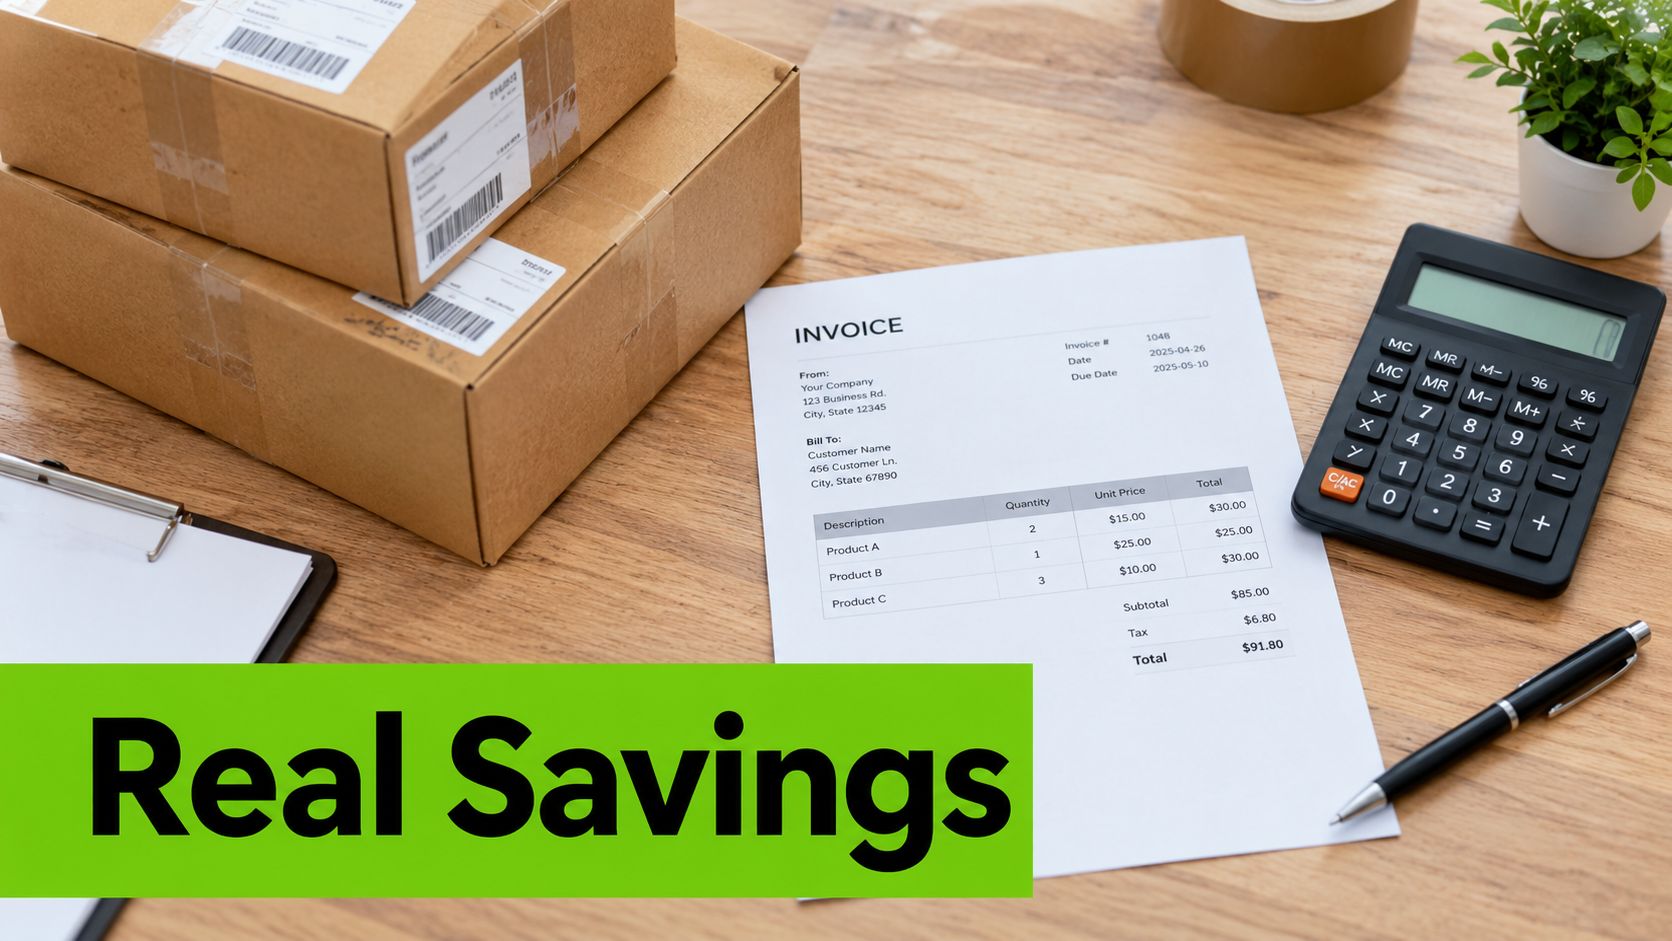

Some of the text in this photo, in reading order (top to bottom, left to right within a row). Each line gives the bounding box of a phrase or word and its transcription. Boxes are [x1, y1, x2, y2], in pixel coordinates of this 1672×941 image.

[795, 317, 904, 343] INVOICE
[1065, 340, 1100, 350] Invoice
[1150, 345, 1206, 357] 2025-04-26
[1388, 337, 1413, 353] MC
[1068, 357, 1092, 365] Date
[1434, 350, 1458, 365] MR
[1153, 360, 1209, 372] 2025-05-10
[1376, 362, 1404, 379] MC
[800, 370, 830, 379] From:
[1071, 370, 1118, 381] Due Date
[801, 378, 874, 392] Your Company
[1422, 375, 1449, 392] MR
[803, 389, 887, 406] 123 Business Rd.
[1467, 389, 1493, 403] M-
[803, 403, 887, 419] City, State 12345
[1421, 404, 1433, 419] 7
[1514, 402, 1541, 417] M+
[1463, 418, 1477, 433] 8
[806, 436, 842, 446] Bill To:
[1406, 432, 1419, 447] 4
[1511, 430, 1524, 446] 9
[808, 444, 891, 460] Customer Name
[1452, 445, 1466, 460] 5
[809, 457, 898, 473] 456 Customer Ln.
[1398, 460, 1407, 476] 1
[1499, 459, 1512, 474] 6
[811, 472, 898, 489] City, State 67890
[1196, 478, 1223, 489] Total
[1441, 474, 1455, 489] 2
[1094, 487, 1146, 500] Unit Price
[1383, 489, 1396, 505] 0
[1488, 488, 1501, 503] 3
[1005, 498, 1050, 510] Quantity
[1209, 501, 1247, 513] $30.00
[824, 516, 884, 531] Description
[1109, 512, 1146, 524] $15.00
[1029, 524, 1036, 534] 2
[1215, 526, 1253, 538] $25.00
[826, 543, 880, 556] Product A
[1113, 537, 1151, 550] $25.00
[1034, 550, 1040, 559] 1
[1221, 552, 1259, 564] $30.00
[829, 569, 882, 582] Product B
[1119, 564, 1157, 576] $10.00
[1038, 576, 1045, 585] 3
[1231, 587, 1270, 600] $85.00
[832, 595, 887, 609] Product C
[1123, 599, 1169, 612] Subtotal
[1244, 613, 1276, 625] $6.80
[1128, 628, 1148, 638] Tax
[1242, 639, 1284, 653] $91.80
[1132, 652, 1168, 666] Total
